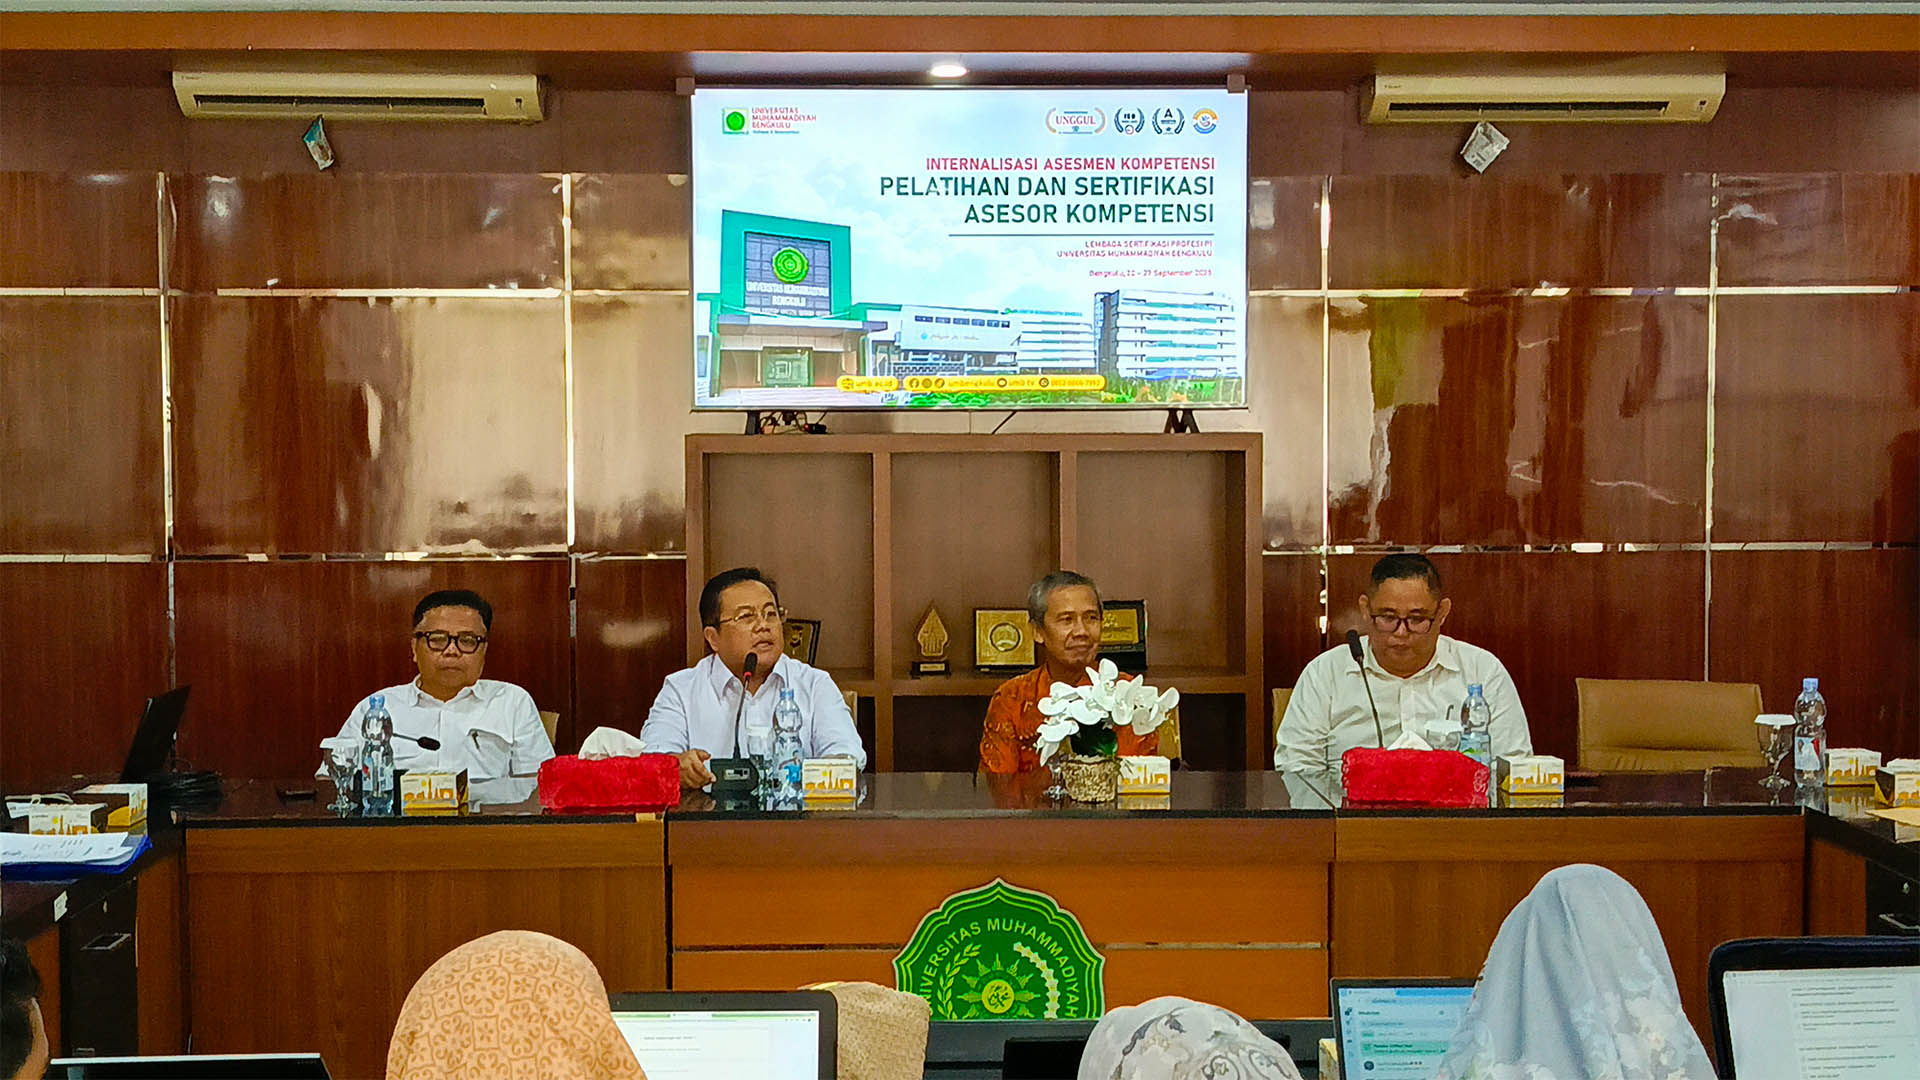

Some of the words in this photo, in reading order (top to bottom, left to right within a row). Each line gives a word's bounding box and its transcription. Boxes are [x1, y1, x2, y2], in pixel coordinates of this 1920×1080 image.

[1055, 115, 1096, 125] UNGGUL
[926, 157, 1038, 170] INTERNALISASI
[1043, 157, 1115, 170] ASESMEN
[1120, 157, 1215, 170] KOMPETENSI
[880, 176, 1009, 196] PELATIHAN
[1018, 176, 1066, 196] DAN
[1074, 175, 1214, 196] SERTIFIKASI
[964, 203, 1058, 223] ASESOR
[1066, 202, 1214, 223] KOMPETENSI
[1056, 250, 1106, 258] UNIVERSITAS
[1108, 250, 1171, 258] MUHAMMADIYAH
[987, 918, 1080, 1018] MUHAMMADIYAH
